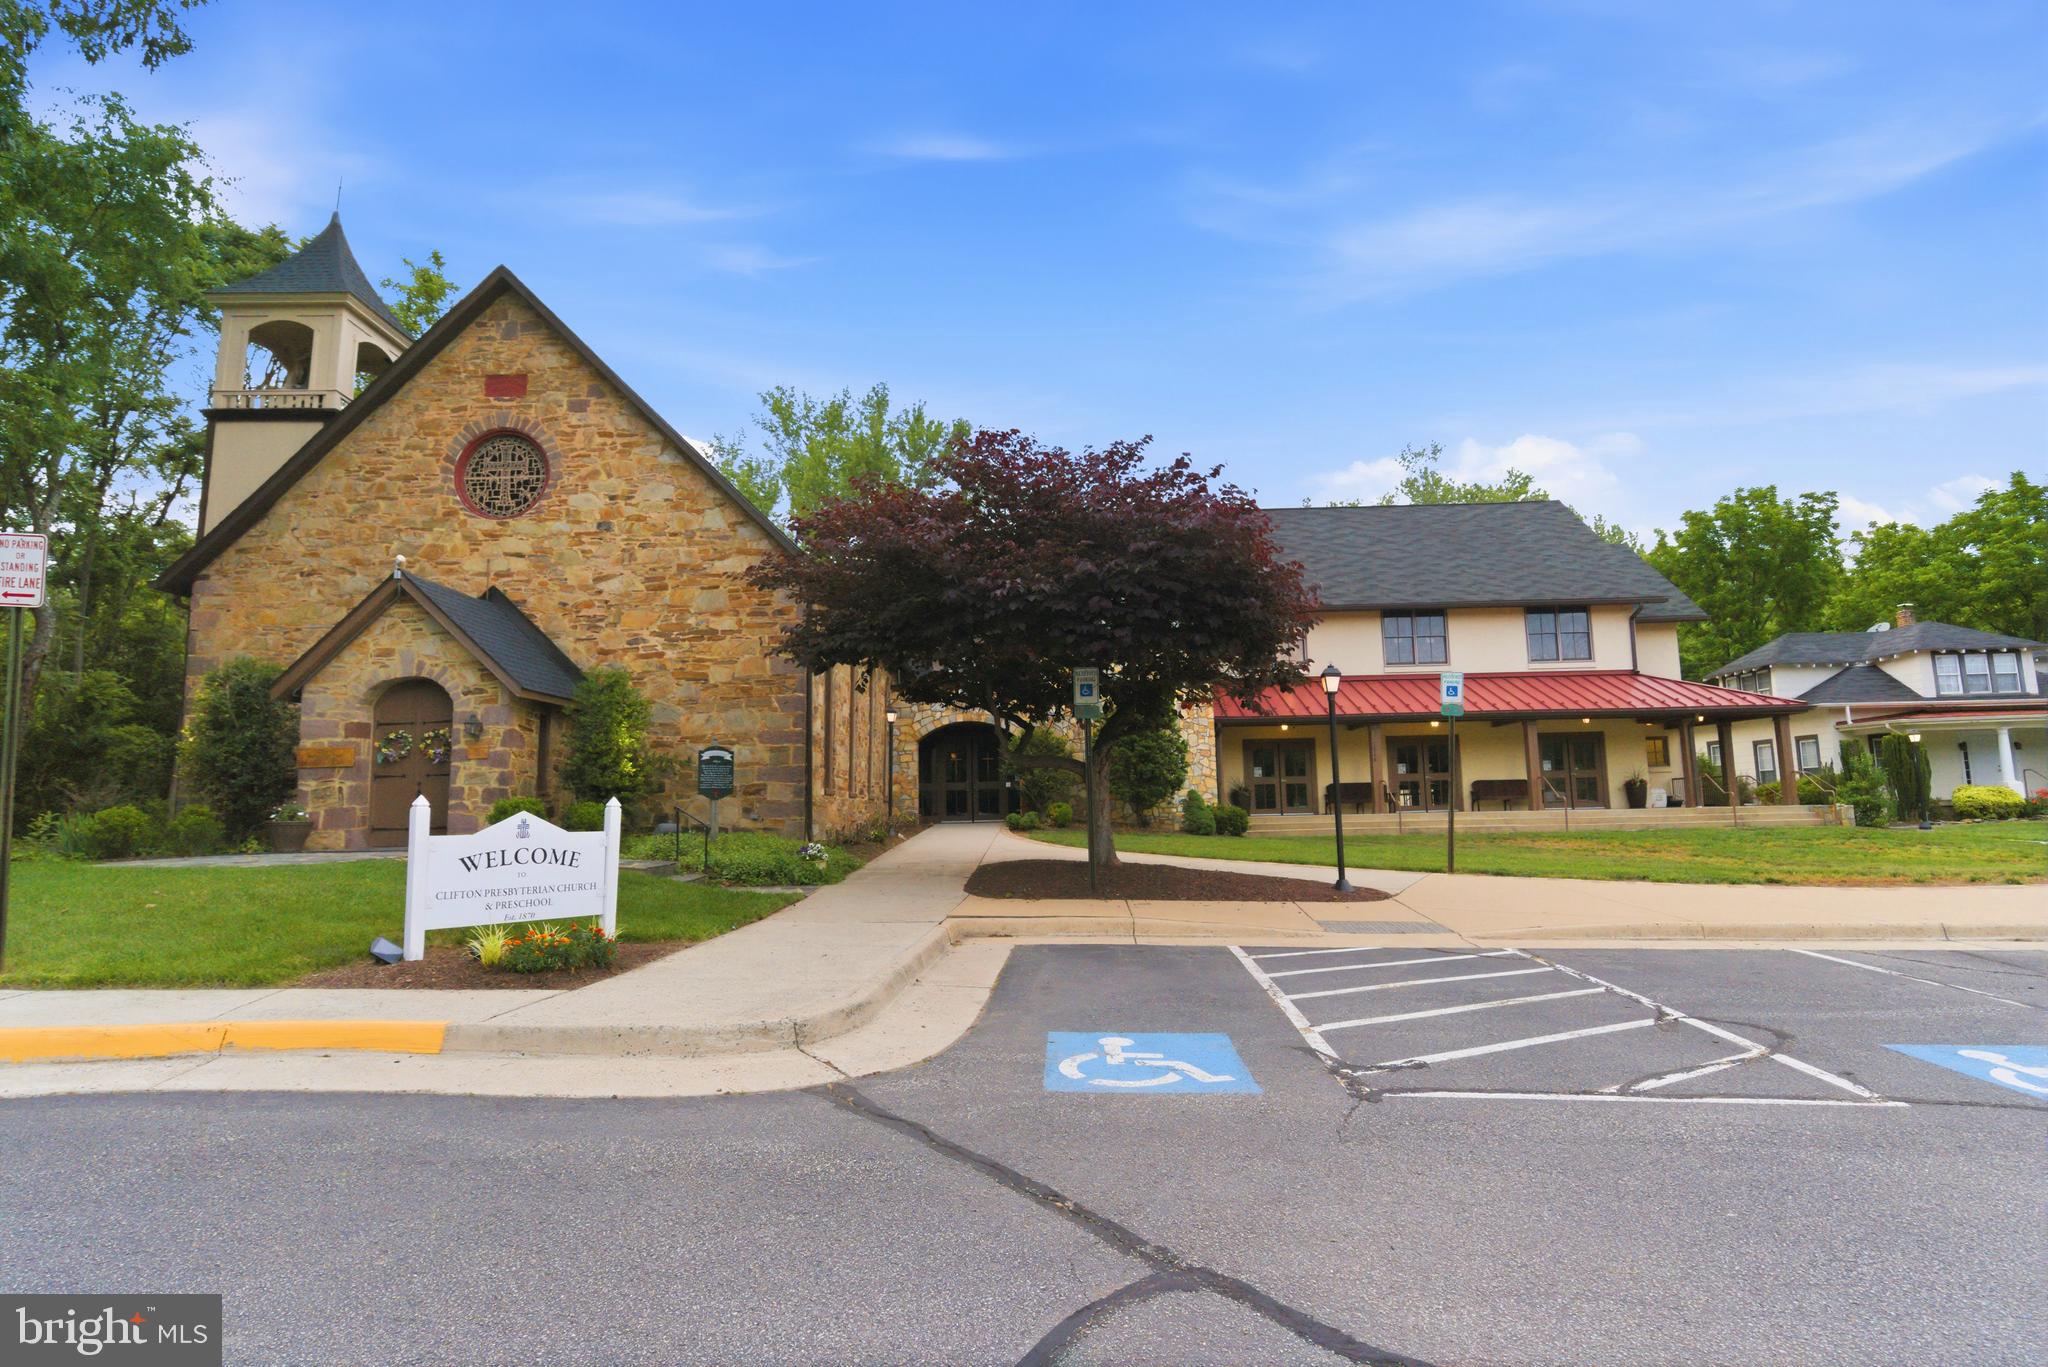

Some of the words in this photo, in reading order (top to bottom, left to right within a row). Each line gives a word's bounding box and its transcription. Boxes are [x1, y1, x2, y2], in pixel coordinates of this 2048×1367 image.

[11, 540, 44, 551] PARKING
[16, 552, 26, 560] OR
[0, 562, 39, 573] STANDING
[18, 577, 41, 589] LANE
[458, 847, 582, 873] WELCOME
[435, 888, 482, 901] CLIFTON
[484, 884, 556, 898] PRESBYTERIAN
[556, 882, 598, 892] CHURCH
[484, 903, 493, 911] &
[495, 898, 553, 910] PRESCHOOL
